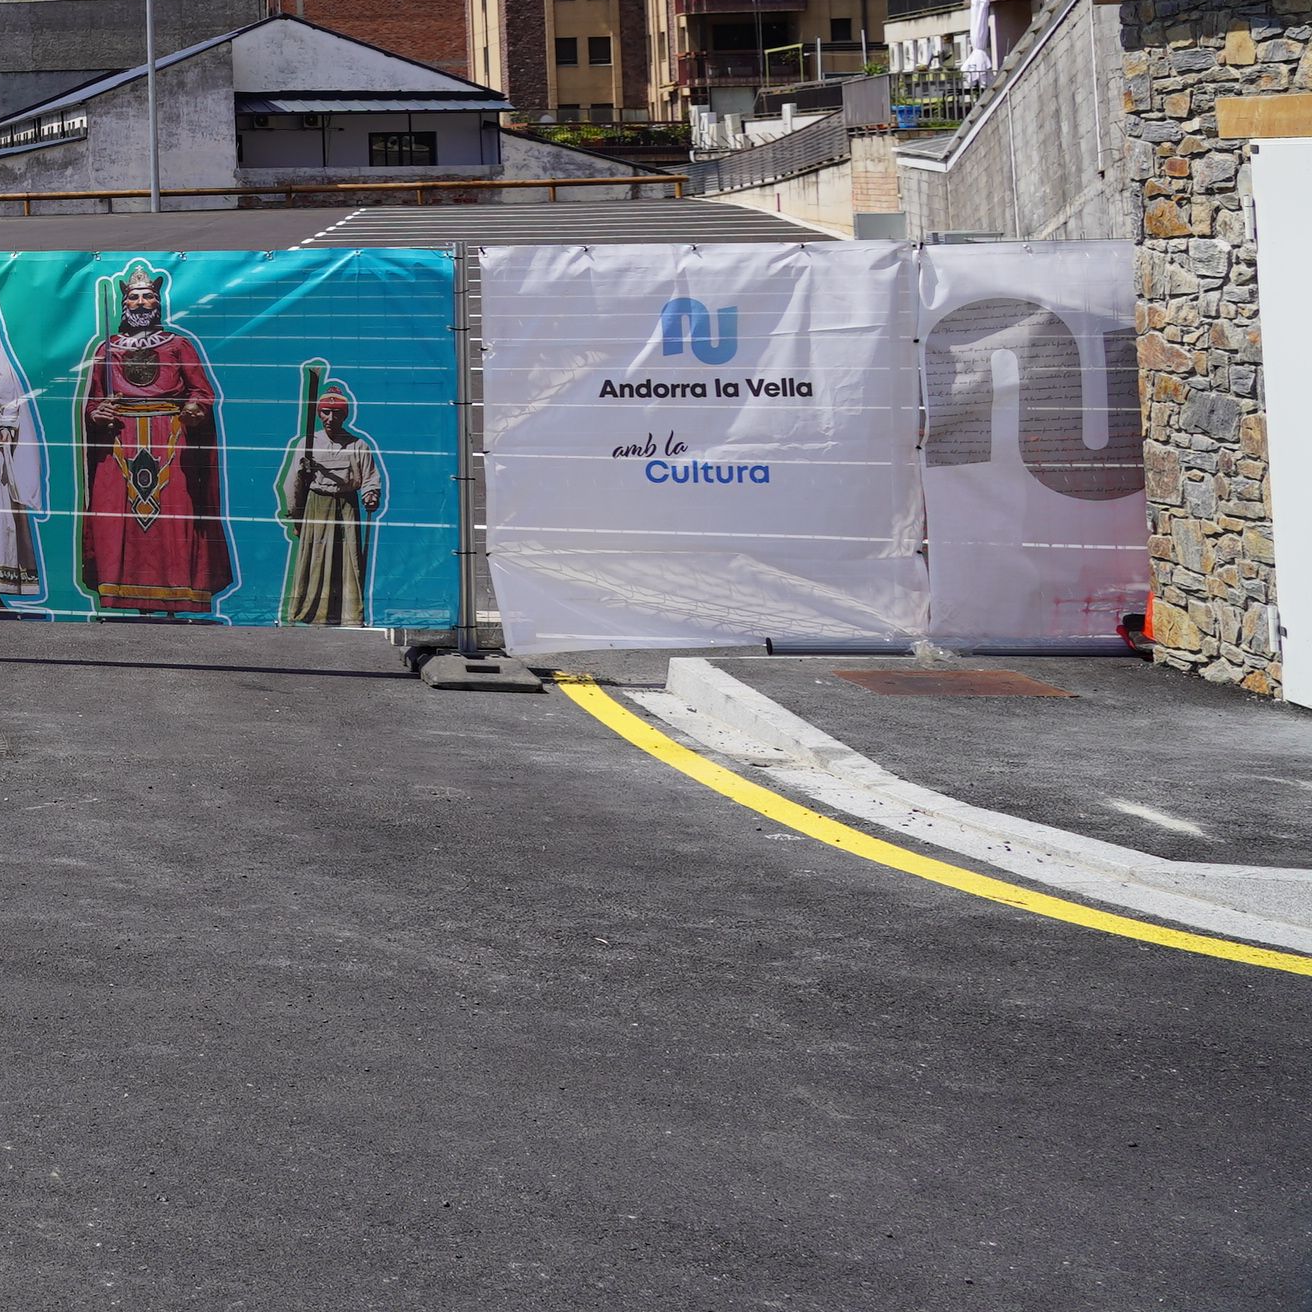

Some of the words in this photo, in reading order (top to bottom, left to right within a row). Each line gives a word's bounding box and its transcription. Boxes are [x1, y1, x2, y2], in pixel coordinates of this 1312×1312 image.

[598, 379, 706, 399] Andorra
[715, 378, 738, 399] la
[745, 378, 813, 399] Vella
[612, 431, 657, 459] amb
[665, 429, 688, 457] la
[645, 460, 770, 485] Cultura
